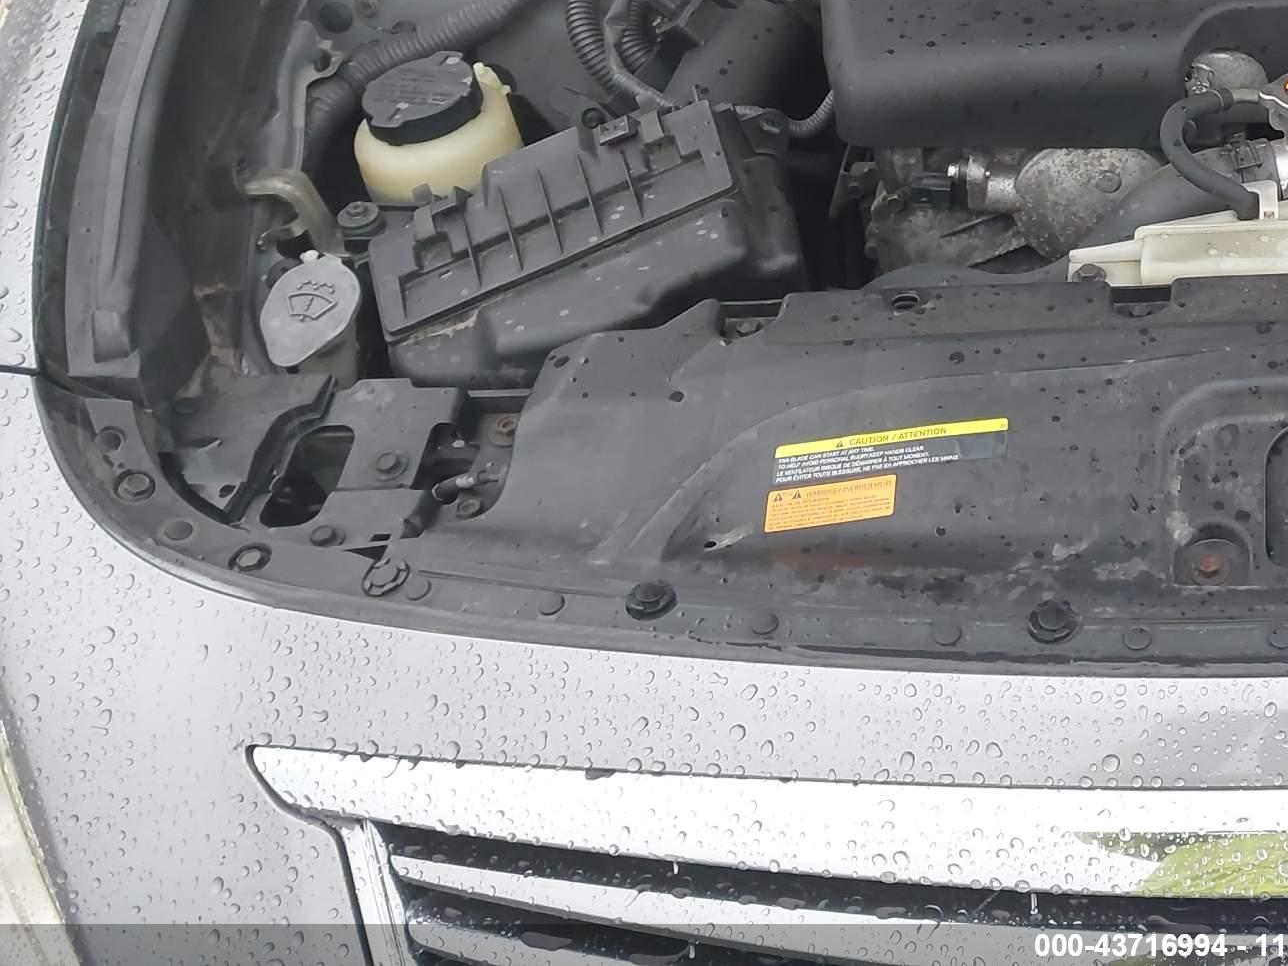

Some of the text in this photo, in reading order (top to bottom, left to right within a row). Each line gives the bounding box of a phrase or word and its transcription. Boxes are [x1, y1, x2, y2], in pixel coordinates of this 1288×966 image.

[850, 435, 889, 446] CAUTION
[899, 428, 947, 440] ATTENTION
[819, 456, 850, 464] PERSONAL
[884, 448, 904, 456] HANDS
[892, 458, 928, 468] APPROCHER
[806, 488, 837, 498] WARNING
